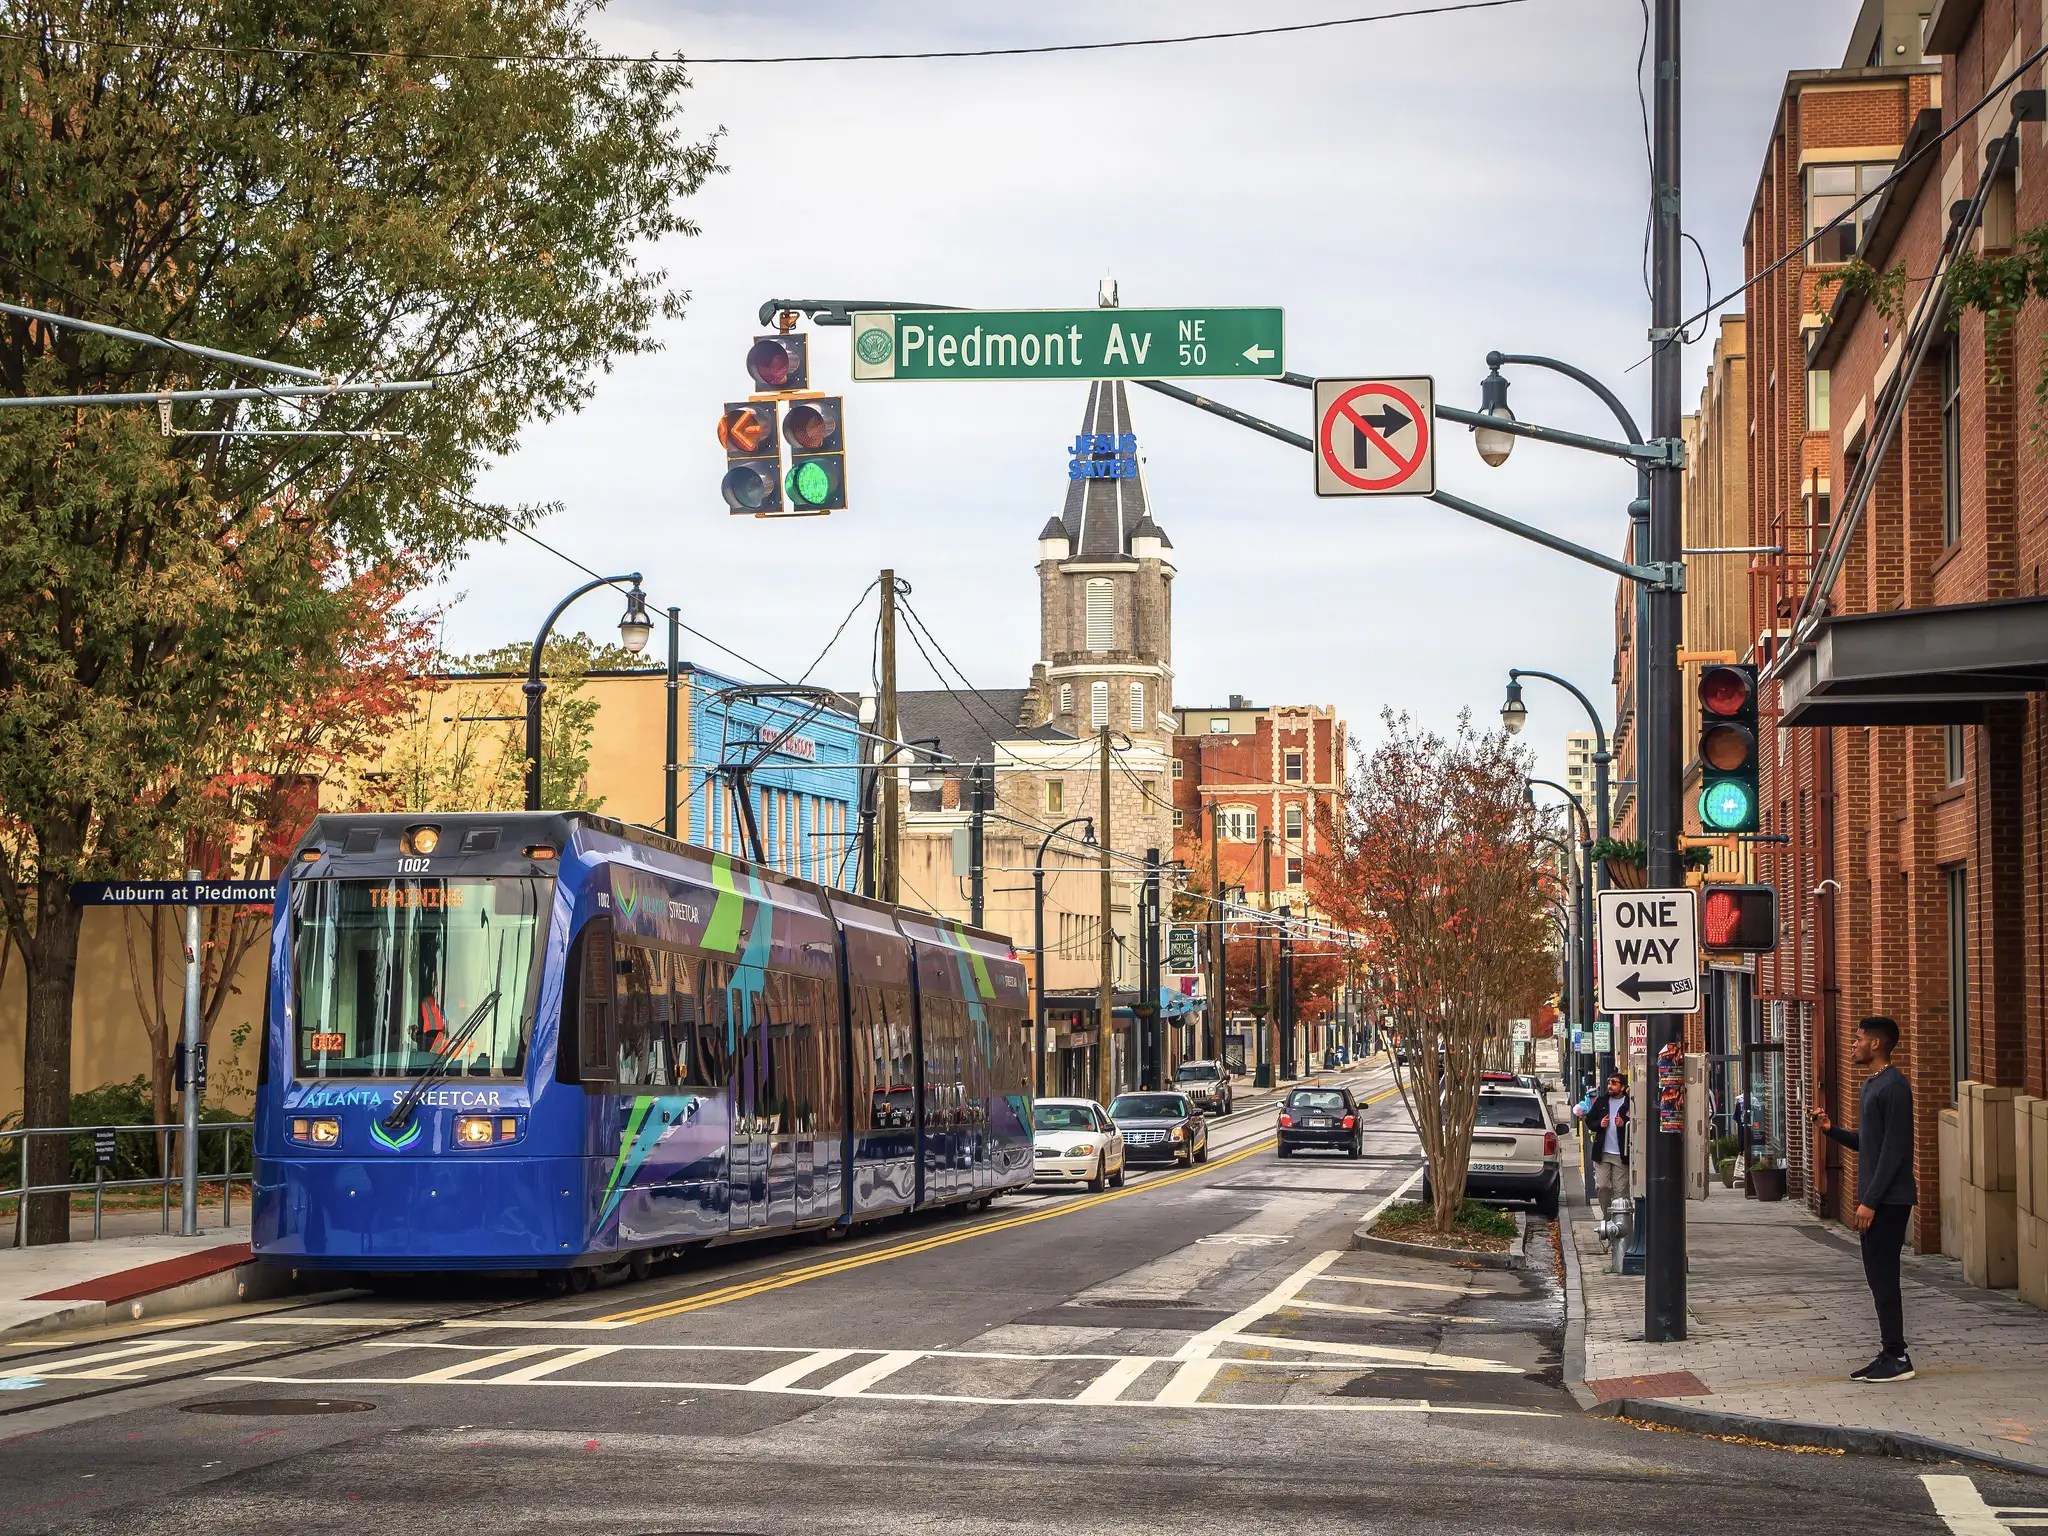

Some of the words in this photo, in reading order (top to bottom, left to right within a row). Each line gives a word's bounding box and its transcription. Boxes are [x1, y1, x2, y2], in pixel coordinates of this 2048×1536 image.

[1179, 320, 1206, 341] NE
[902, 324, 1083, 367] Piedmont
[1103, 323, 1152, 365] Av
[1179, 343, 1207, 366] 50
[1068, 433, 1137, 455] JESUS
[1068, 458, 1137, 480] SAVES
[397, 858, 430, 873] 1002
[102, 886, 164, 901] Auburn
[171, 887, 189, 900] at
[195, 885, 277, 900] Piedmont
[369, 888, 464, 908] TRAINING
[597, 892, 610, 909] 1002
[668, 900, 700, 924] STREETCAR
[1616, 902, 1678, 928] ONE
[1615, 938, 1680, 965] WAY
[1636, 1025, 1646, 1036] NO
[1629, 1037, 1647, 1047] PARK
[305, 1091, 382, 1106] ATLANTA
[1472, 1163, 1504, 1172] 3212413
